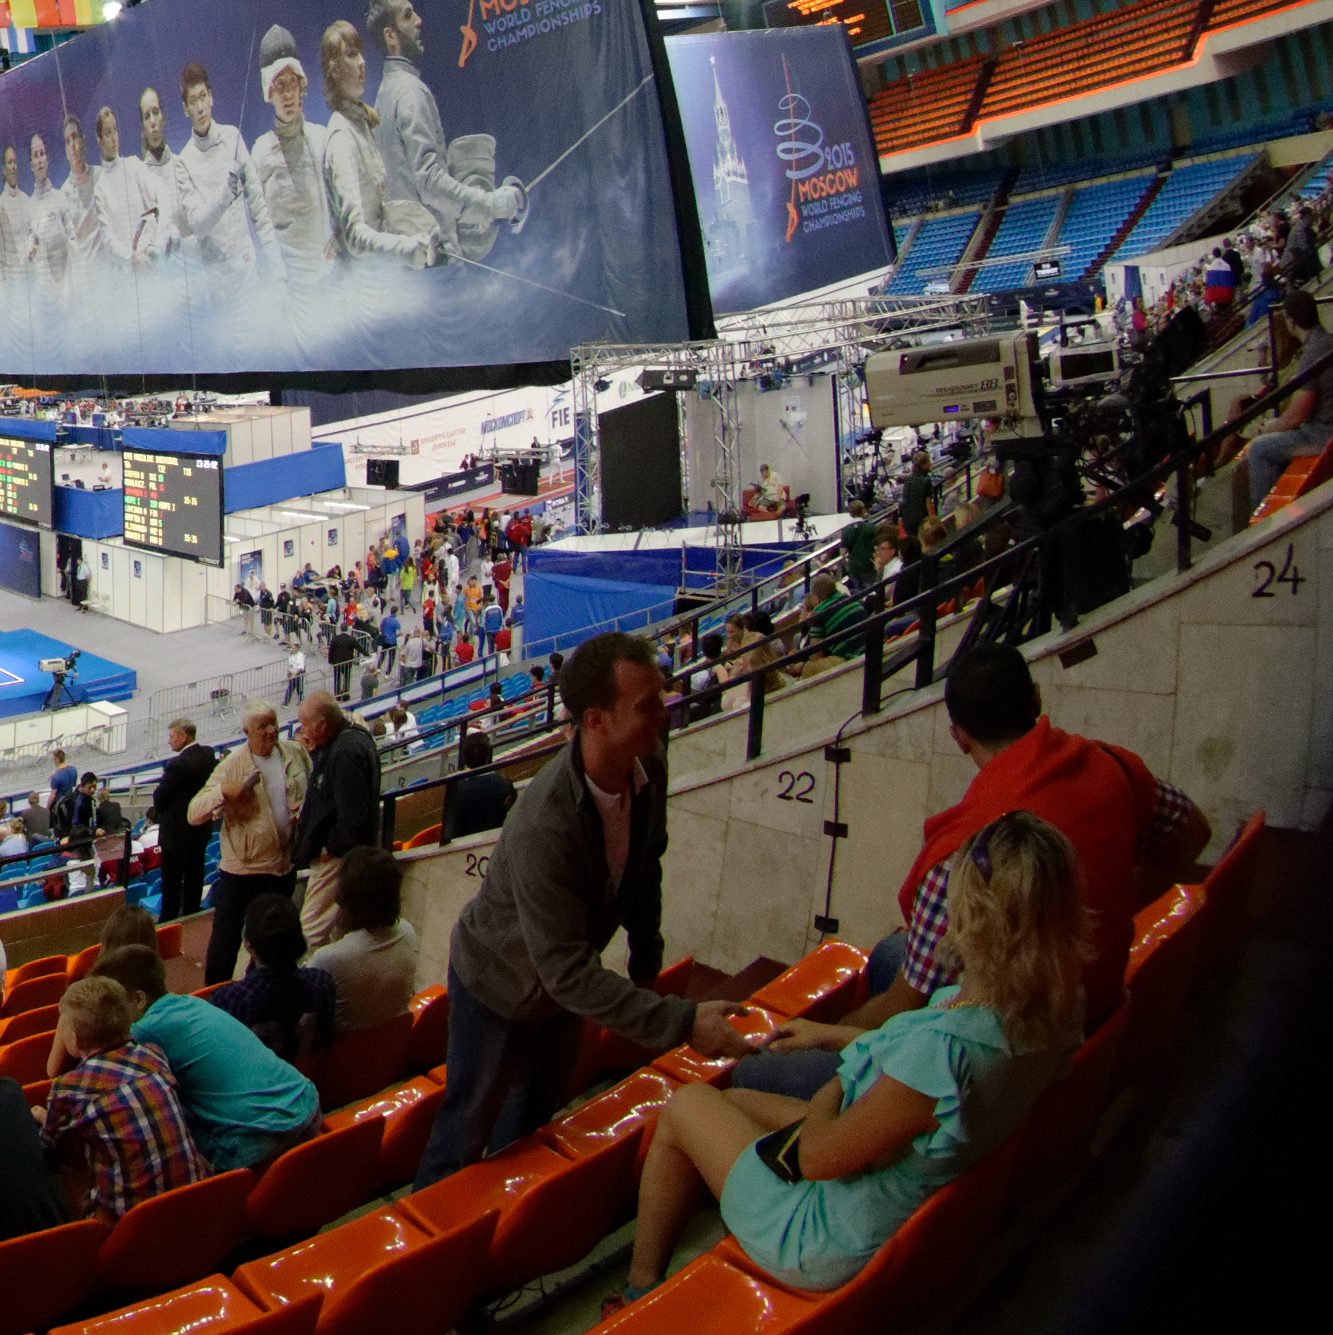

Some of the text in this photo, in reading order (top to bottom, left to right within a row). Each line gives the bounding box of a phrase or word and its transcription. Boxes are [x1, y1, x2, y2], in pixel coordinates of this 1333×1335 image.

[484, 8, 531, 34] WORLD
[487, 0, 602, 51] CHAMPIONSHIPS
[825, 142, 855, 171] 2015
[798, 167, 858, 202] MOSCOW
[801, 191, 862, 216] WORLD FENCING
[803, 206, 865, 233] CHAMPIONSHIPS
[480, 409, 526, 435] МОСКОМСПОРТ
[551, 407, 570, 429] FIE
[1251, 544, 1306, 598] 24
[777, 771, 816, 803] 22
